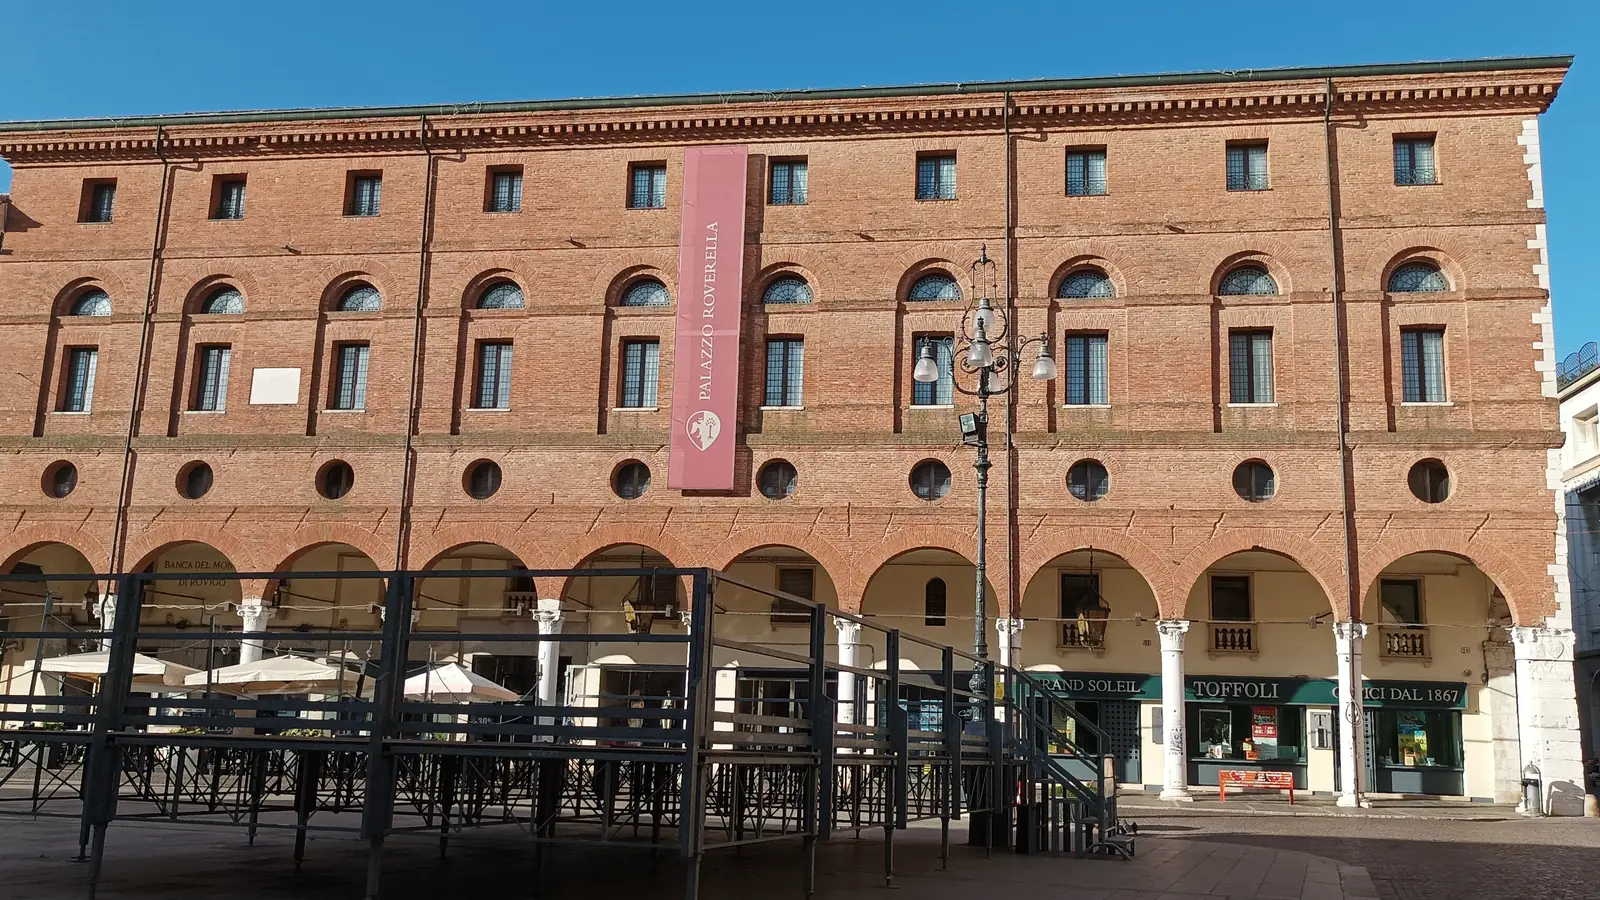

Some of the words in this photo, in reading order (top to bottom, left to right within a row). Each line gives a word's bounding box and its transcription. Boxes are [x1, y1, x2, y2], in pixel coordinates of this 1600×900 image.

[702, 221, 719, 319] ROVERELLA
[698, 323, 714, 401] PALAZZO
[164, 561, 193, 569] BANCA
[194, 561, 211, 569] DEL
[190, 579, 227, 587] ROVIGO
[1041, 678, 1085, 691] RAND
[1088, 679, 1141, 693] SOLEIL
[1193, 681, 1279, 699] TOFFOLI
[1390, 687, 1424, 701] DAL
[1427, 689, 1459, 702] 1867
[1313, 714, 1327, 727] T
